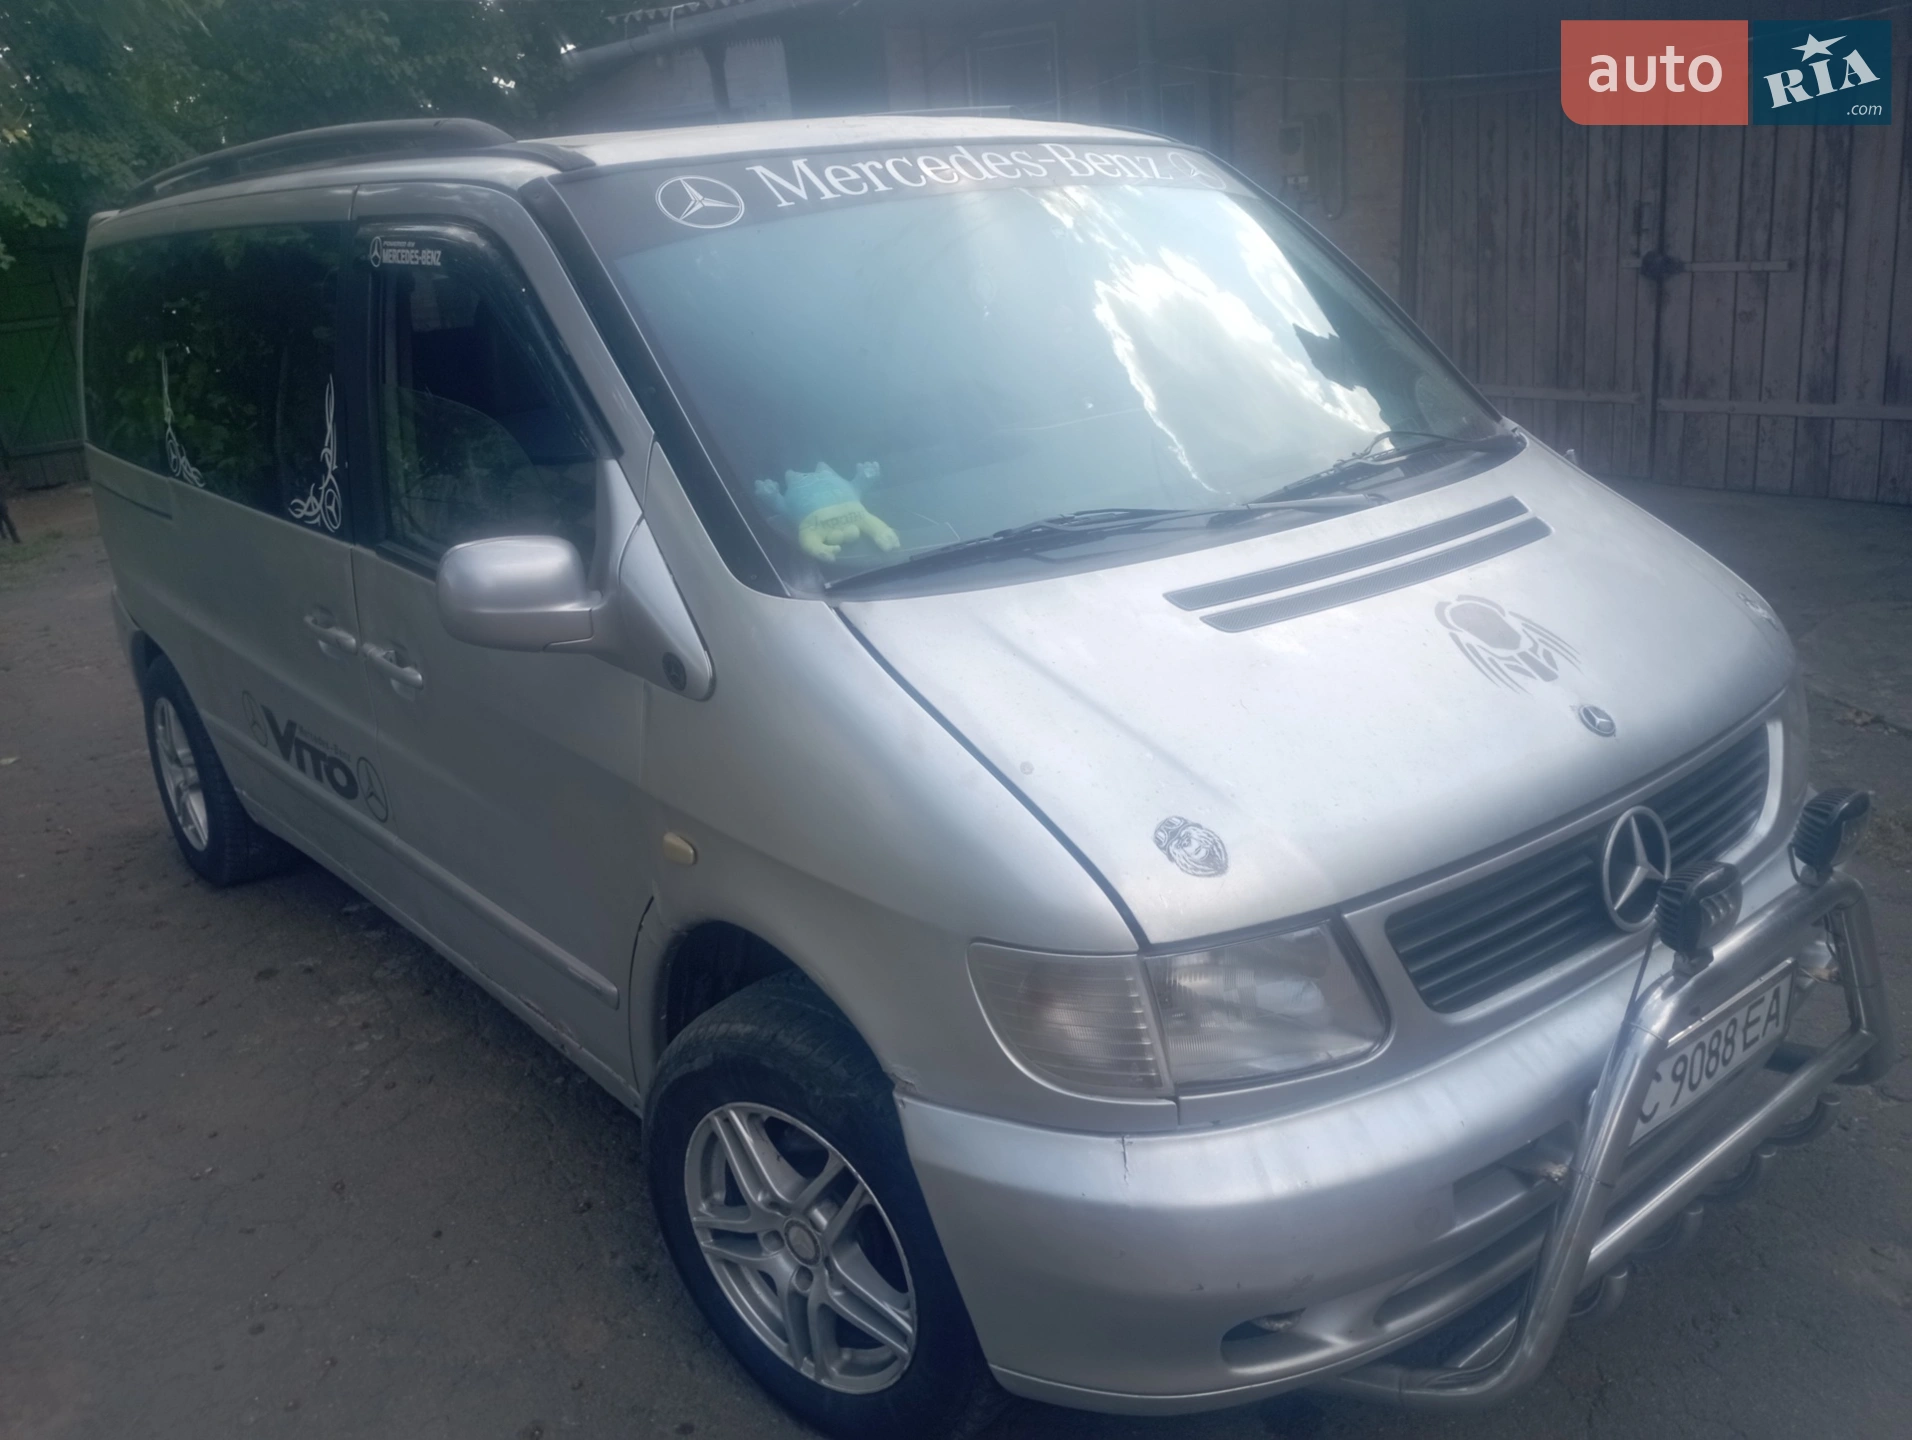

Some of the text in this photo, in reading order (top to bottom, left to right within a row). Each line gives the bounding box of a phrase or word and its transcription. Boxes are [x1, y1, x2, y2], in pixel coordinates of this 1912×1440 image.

[745, 143, 1174, 208] Mercedes-Benz
[382, 248, 442, 266] MERCEDES-BENZ
[1669, 1017, 1738, 1109] 9088
[1742, 986, 1782, 1054] EA
